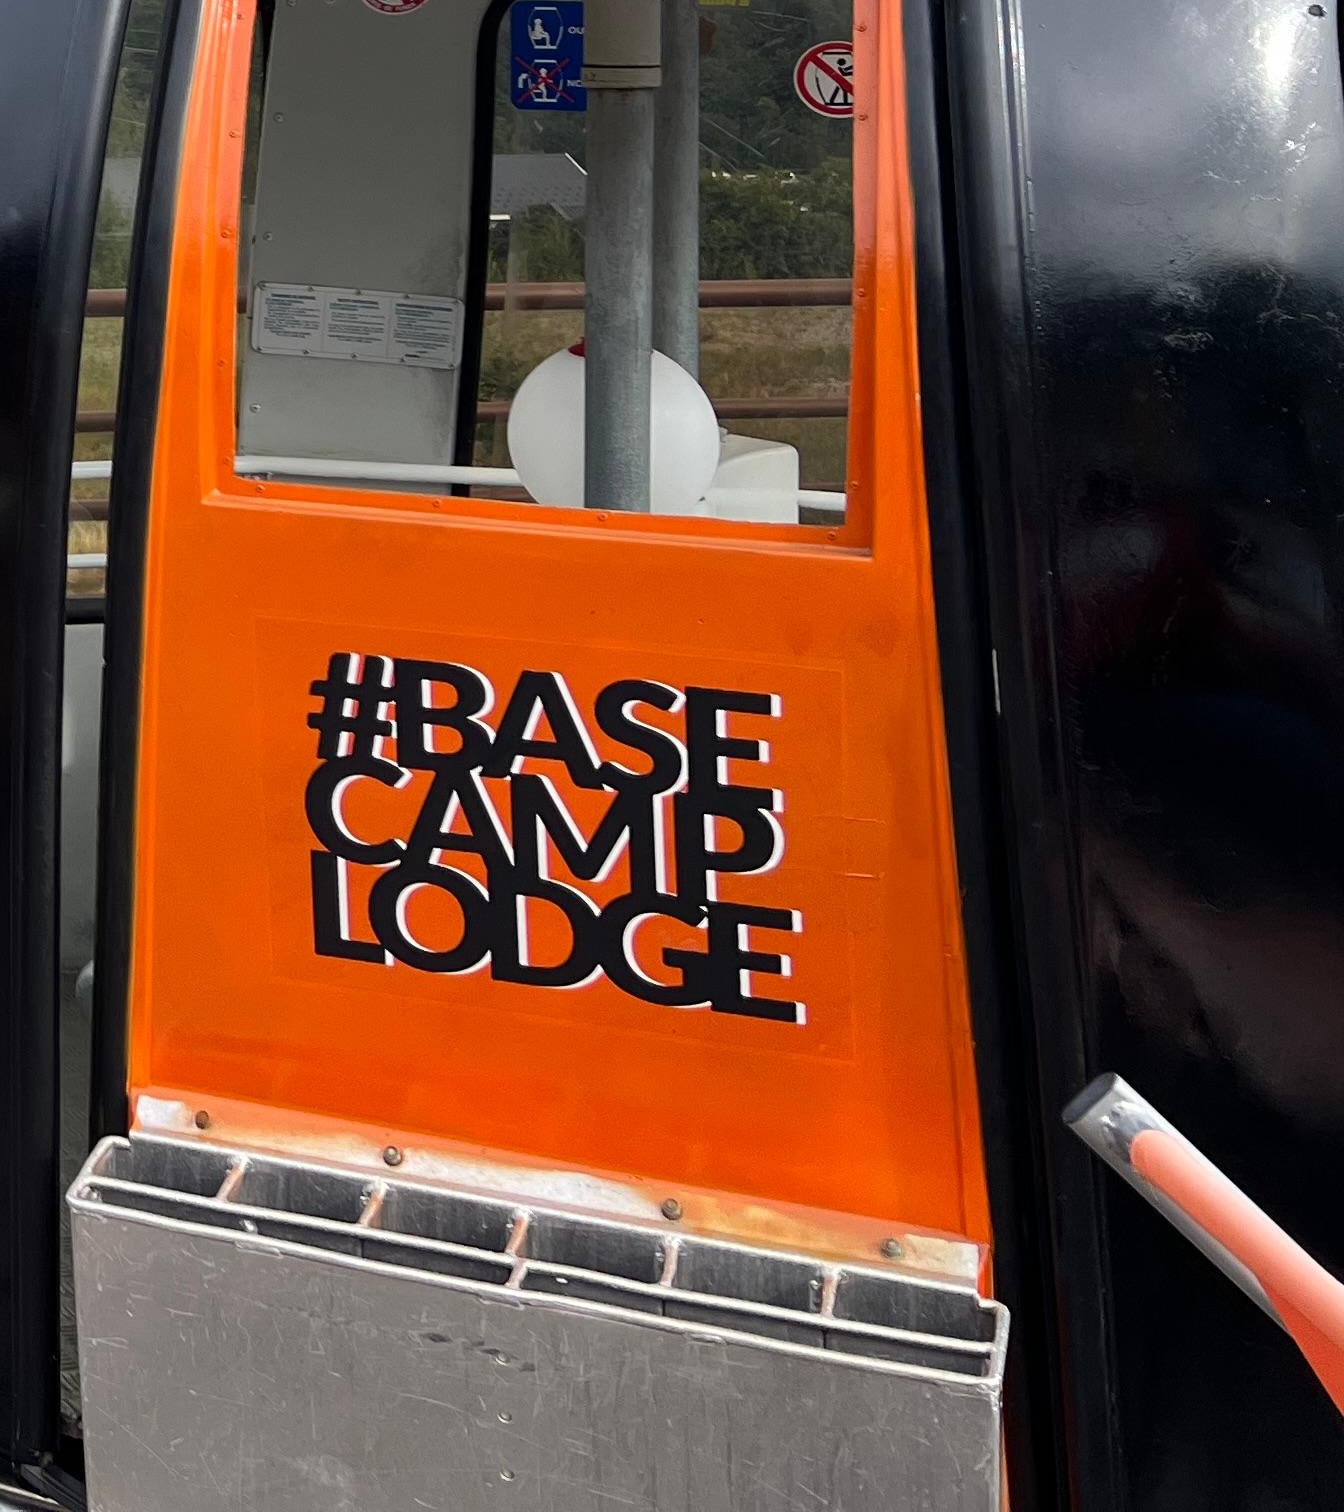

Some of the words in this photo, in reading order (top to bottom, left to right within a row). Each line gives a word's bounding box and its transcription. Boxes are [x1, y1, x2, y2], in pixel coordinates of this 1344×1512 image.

[307, 652, 782, 812] #BASE
[305, 756, 785, 903] CAMP
[310, 850, 807, 1025] LODGE
